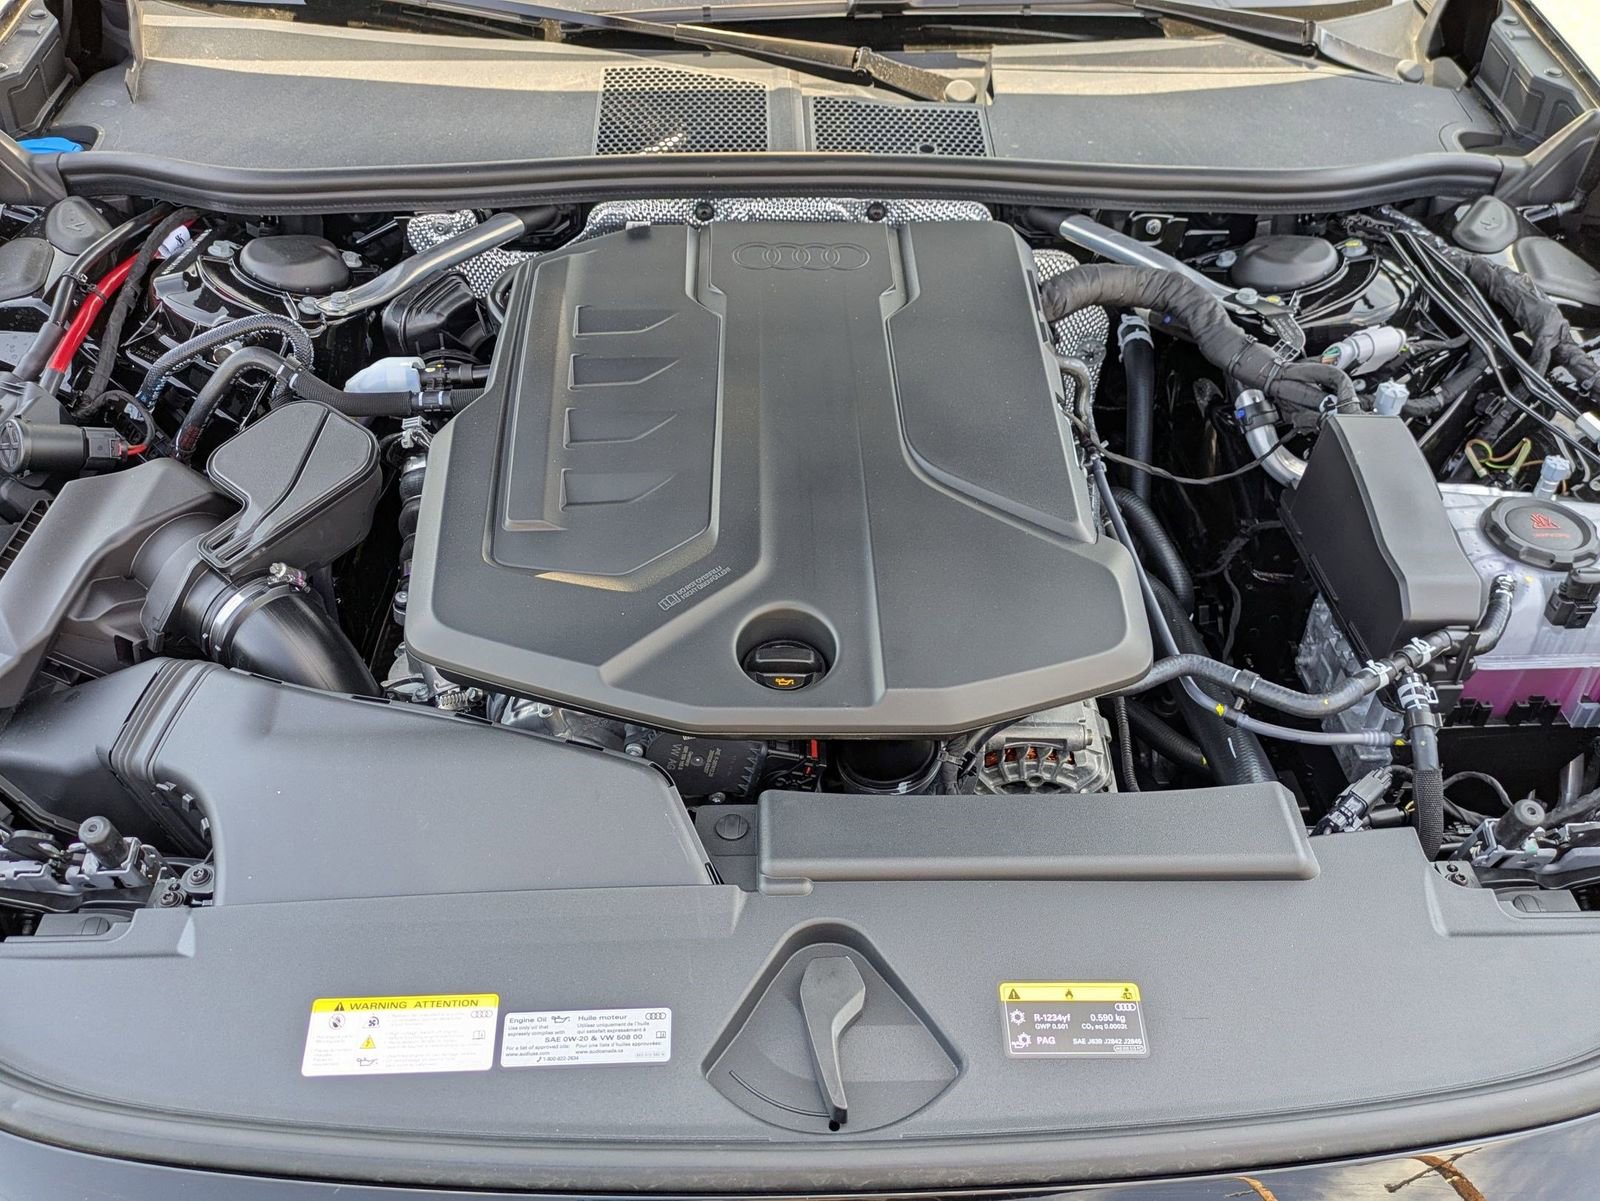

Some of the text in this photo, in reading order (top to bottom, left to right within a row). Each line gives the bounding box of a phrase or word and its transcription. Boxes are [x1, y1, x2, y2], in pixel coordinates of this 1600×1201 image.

[667, 743, 683, 771] VW AG
[350, 999, 479, 1011] WARNING ATTENTION
[1033, 1013, 1126, 1023] R-1234yf 0.590 kg
[1036, 1036, 1056, 1045] PAG
